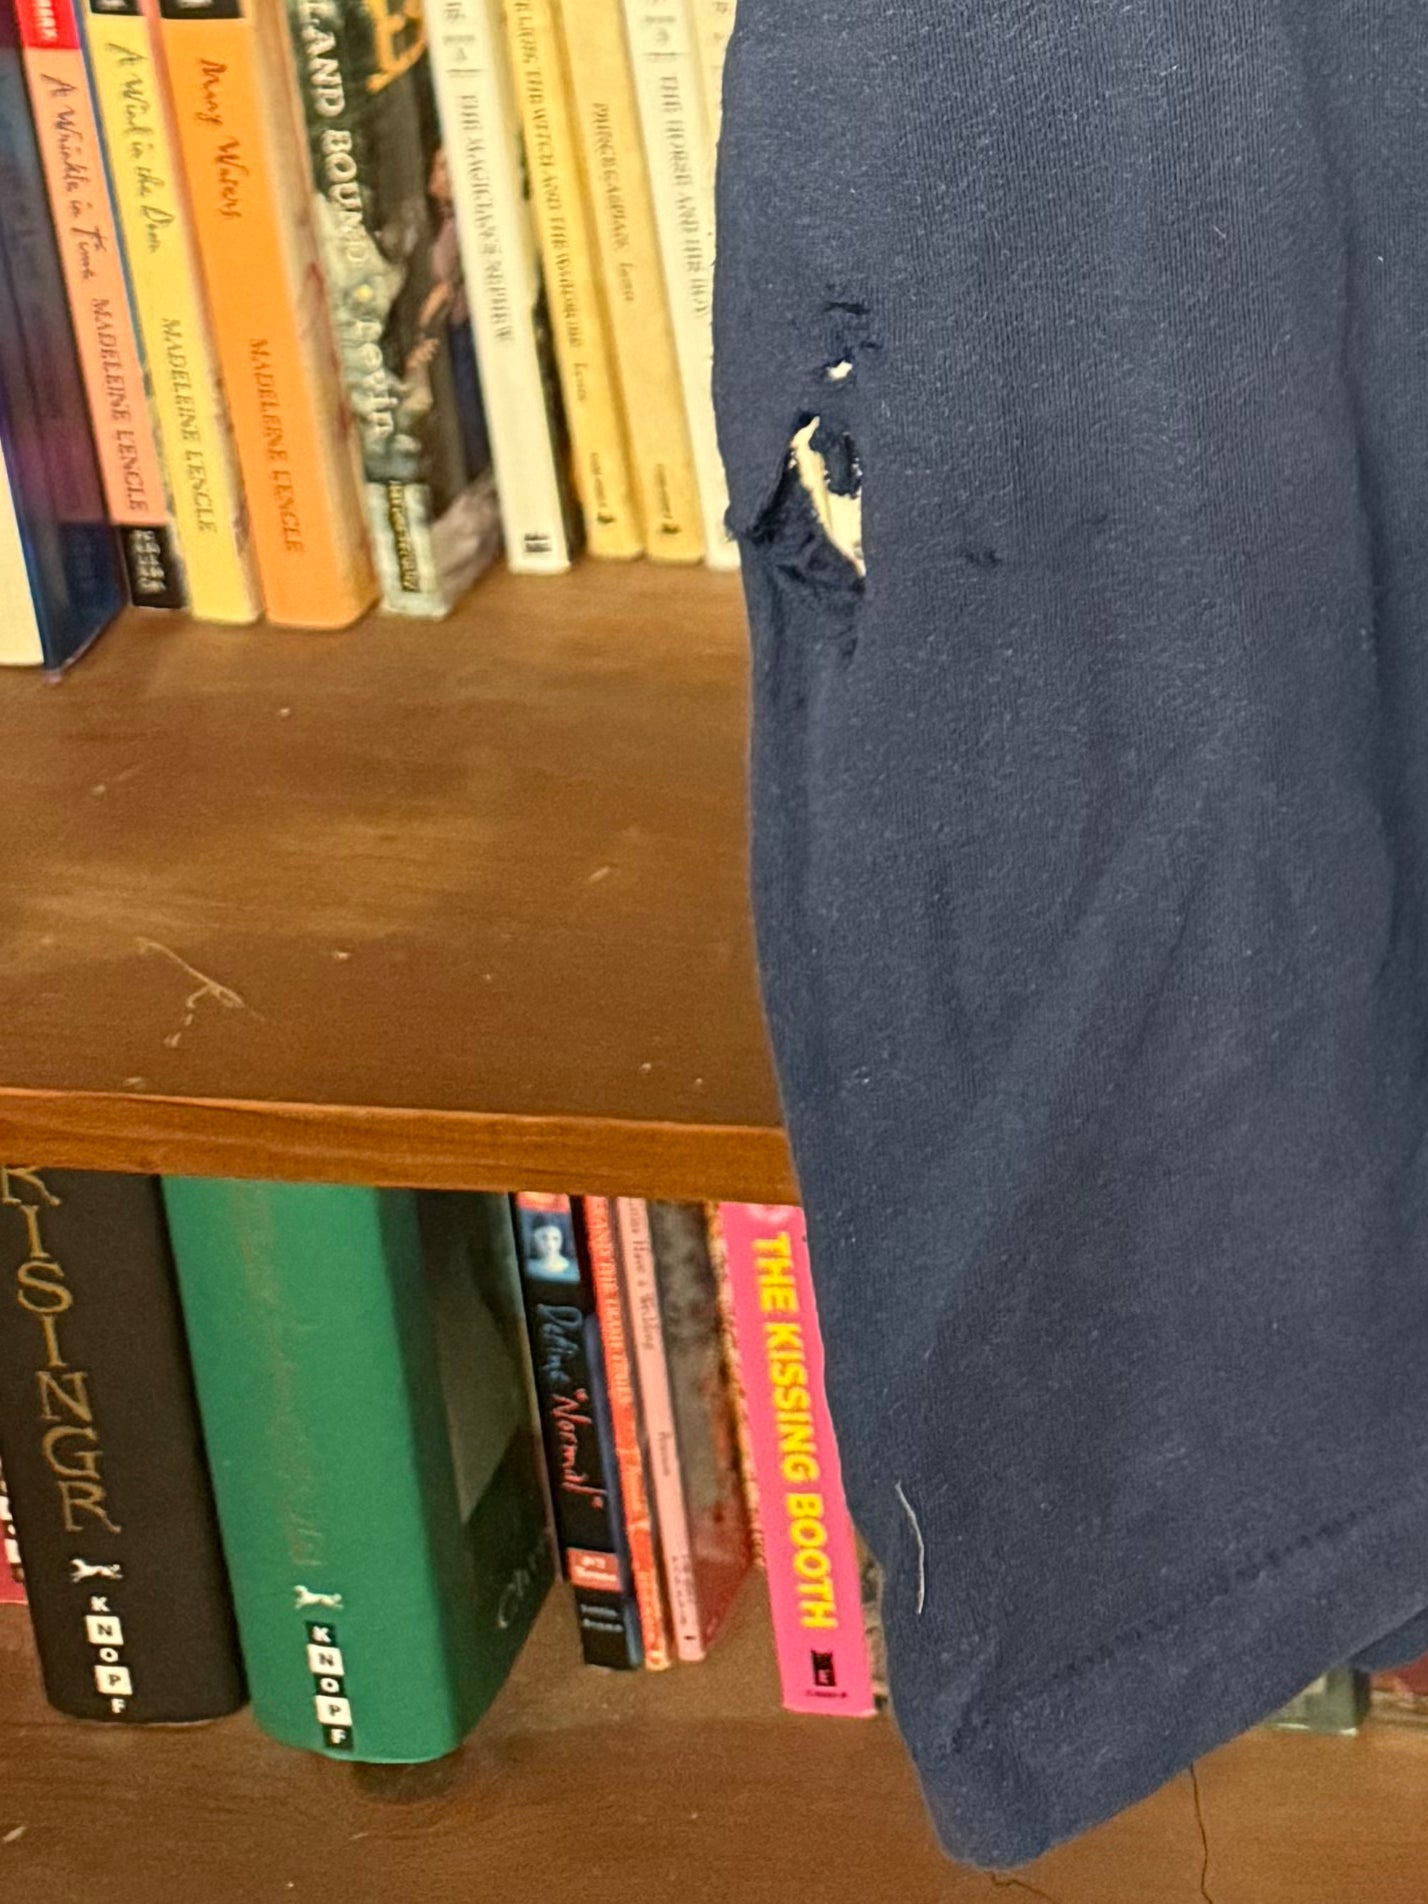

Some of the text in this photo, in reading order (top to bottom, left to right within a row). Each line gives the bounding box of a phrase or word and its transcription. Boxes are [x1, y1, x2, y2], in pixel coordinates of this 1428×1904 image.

[105, 42, 148, 63] A
[121, 78, 150, 138] Wind
[41, 74, 107, 282] A Wrinkle in Time
[131, 141, 146, 160] in
[195, 58, 248, 220] Many Waters
[321, 129, 369, 263] BOUND
[91, 297, 132, 422] MADELEINE
[161, 317, 201, 442] MADELEINE
[250, 337, 289, 461] MADELEINE
[752, 1232, 798, 1315] THE
[765, 1322, 820, 1482] KISSING
[786, 1491, 839, 1631] BOOTH
[86, 1596, 132, 1714] KNOPF
[308, 1625, 352, 1748] KNOPF
